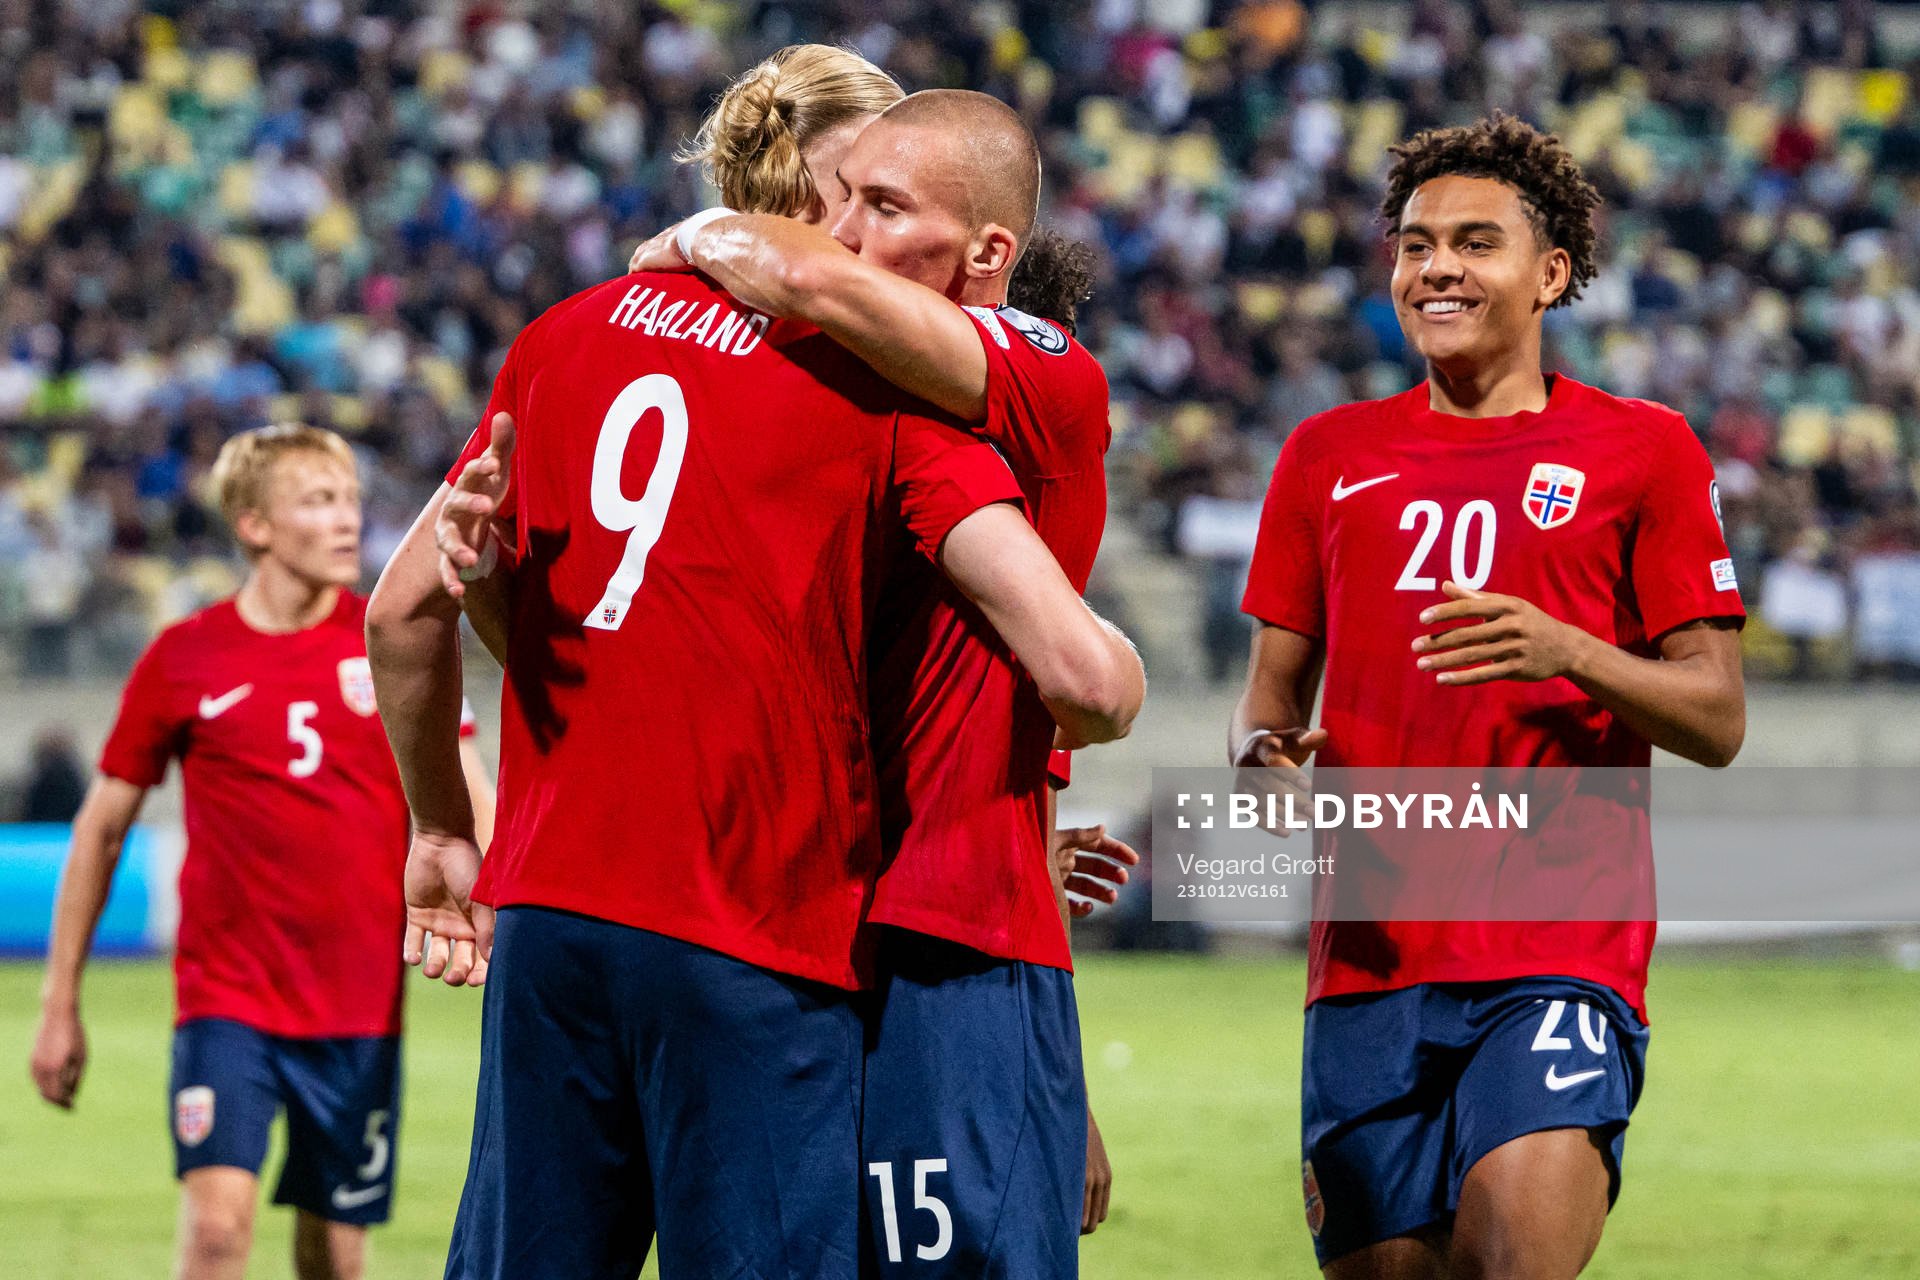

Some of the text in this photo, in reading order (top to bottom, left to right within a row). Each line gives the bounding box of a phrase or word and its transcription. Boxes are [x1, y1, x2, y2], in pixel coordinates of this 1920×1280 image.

[608, 284, 770, 356] HAALAND
[581, 373, 689, 631] 9
[1394, 499, 1498, 591] 20
[286, 700, 324, 779] 5
[357, 1109, 390, 1182] 5
[868, 1158, 953, 1263] 15
